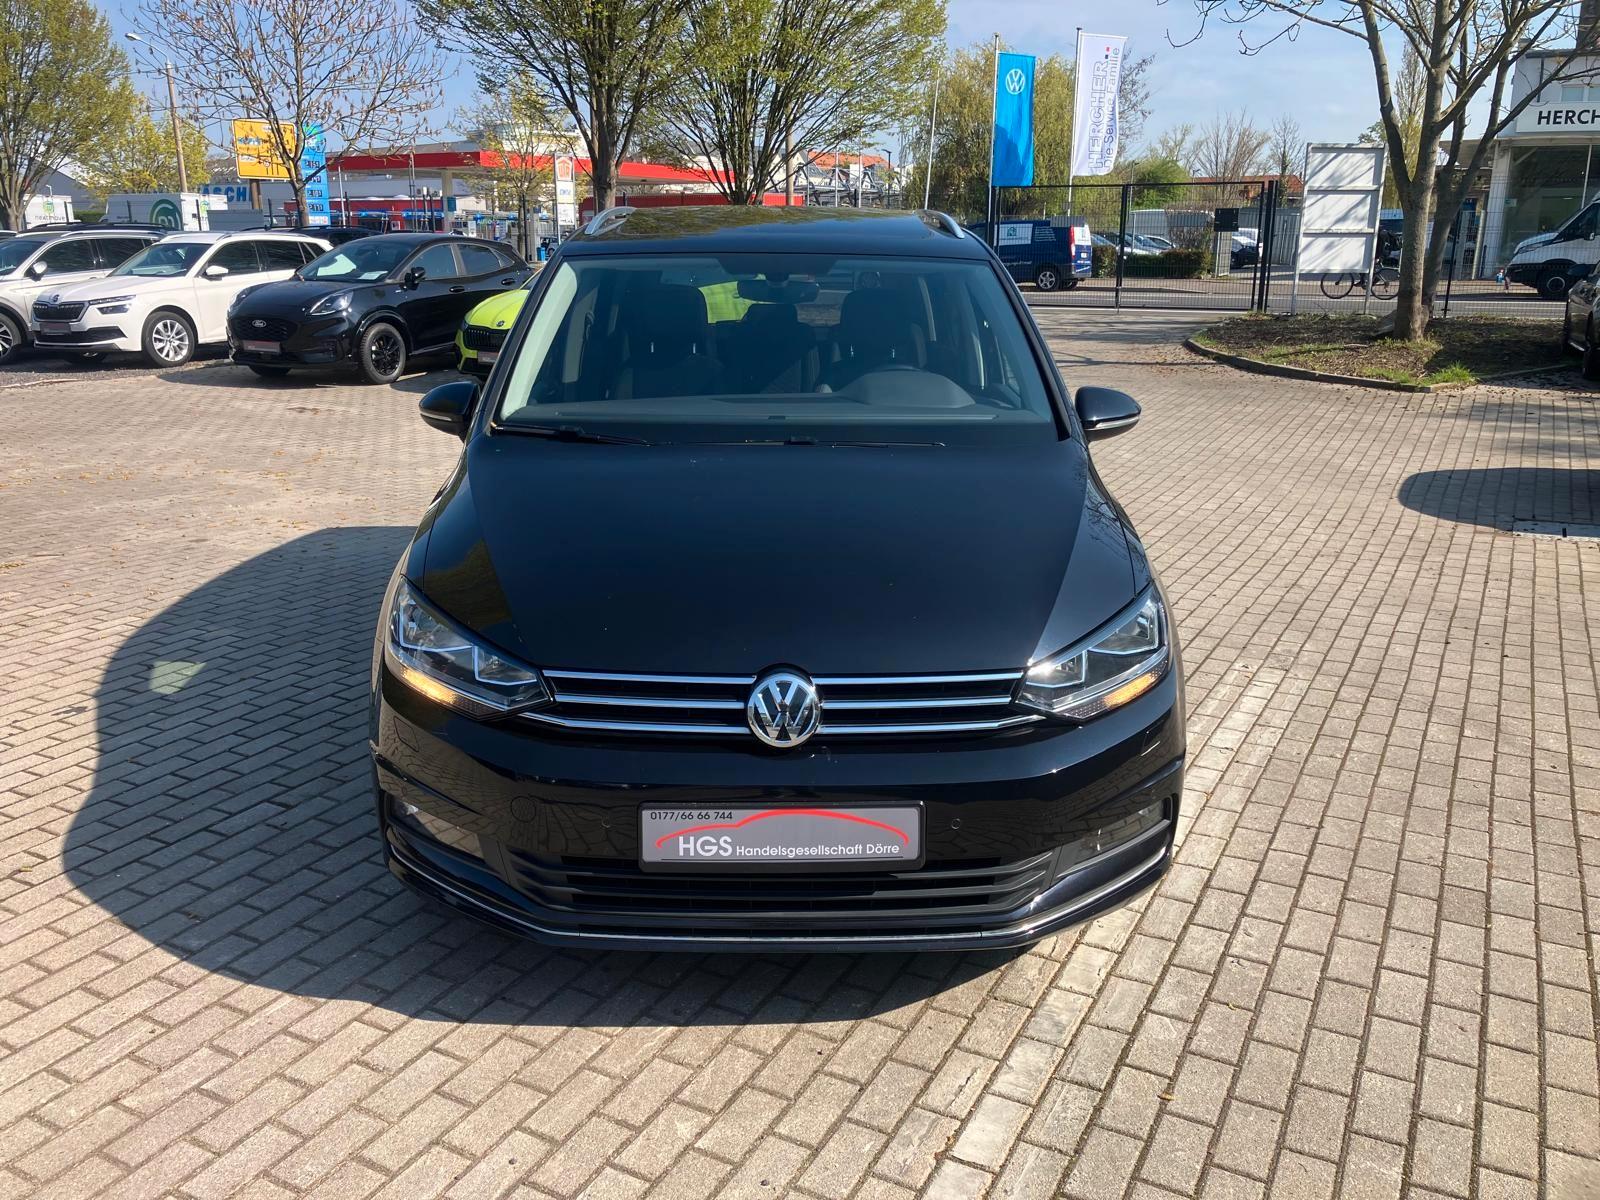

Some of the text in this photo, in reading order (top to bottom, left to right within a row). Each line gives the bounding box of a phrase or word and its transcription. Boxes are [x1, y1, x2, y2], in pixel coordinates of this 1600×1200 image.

[1088, 61, 1109, 169] HERCHER
[650, 811, 733, 821] 0177/66 66 744
[678, 835, 900, 858] HGS Handelsgesellschaft Dörre
